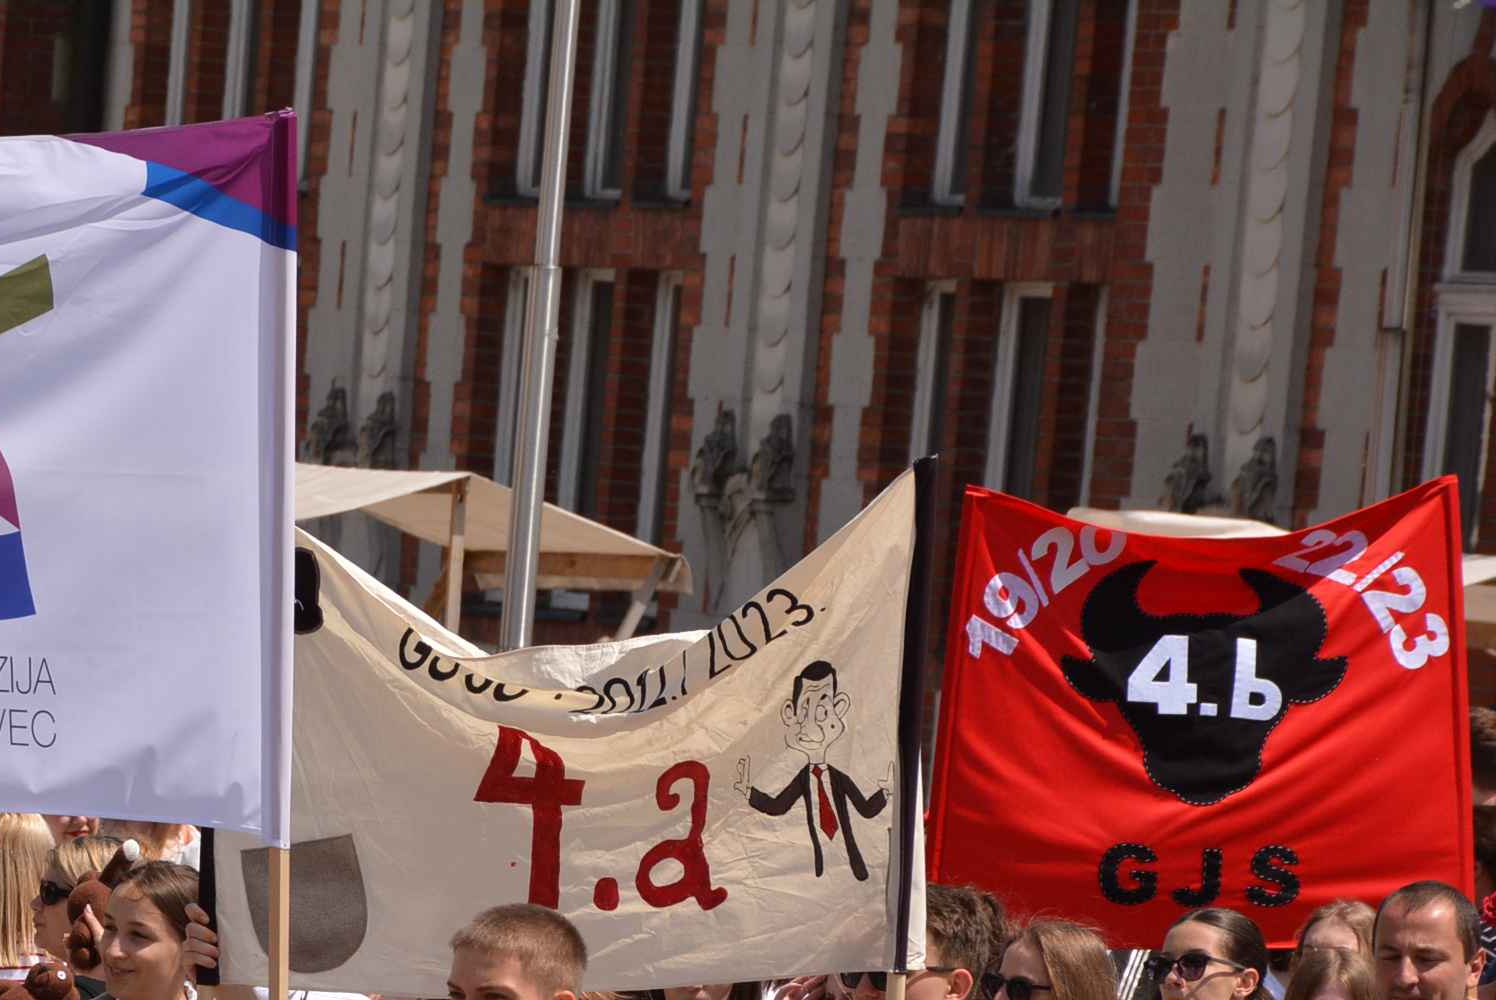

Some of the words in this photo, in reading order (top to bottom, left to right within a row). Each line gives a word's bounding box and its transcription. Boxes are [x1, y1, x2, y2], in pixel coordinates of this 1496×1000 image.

[966, 525, 1128, 660] 19/20
[1271, 528, 1450, 670] 22/23
[1126, 634, 1283, 722] 4.b
[472, 725, 728, 911] 4.a
